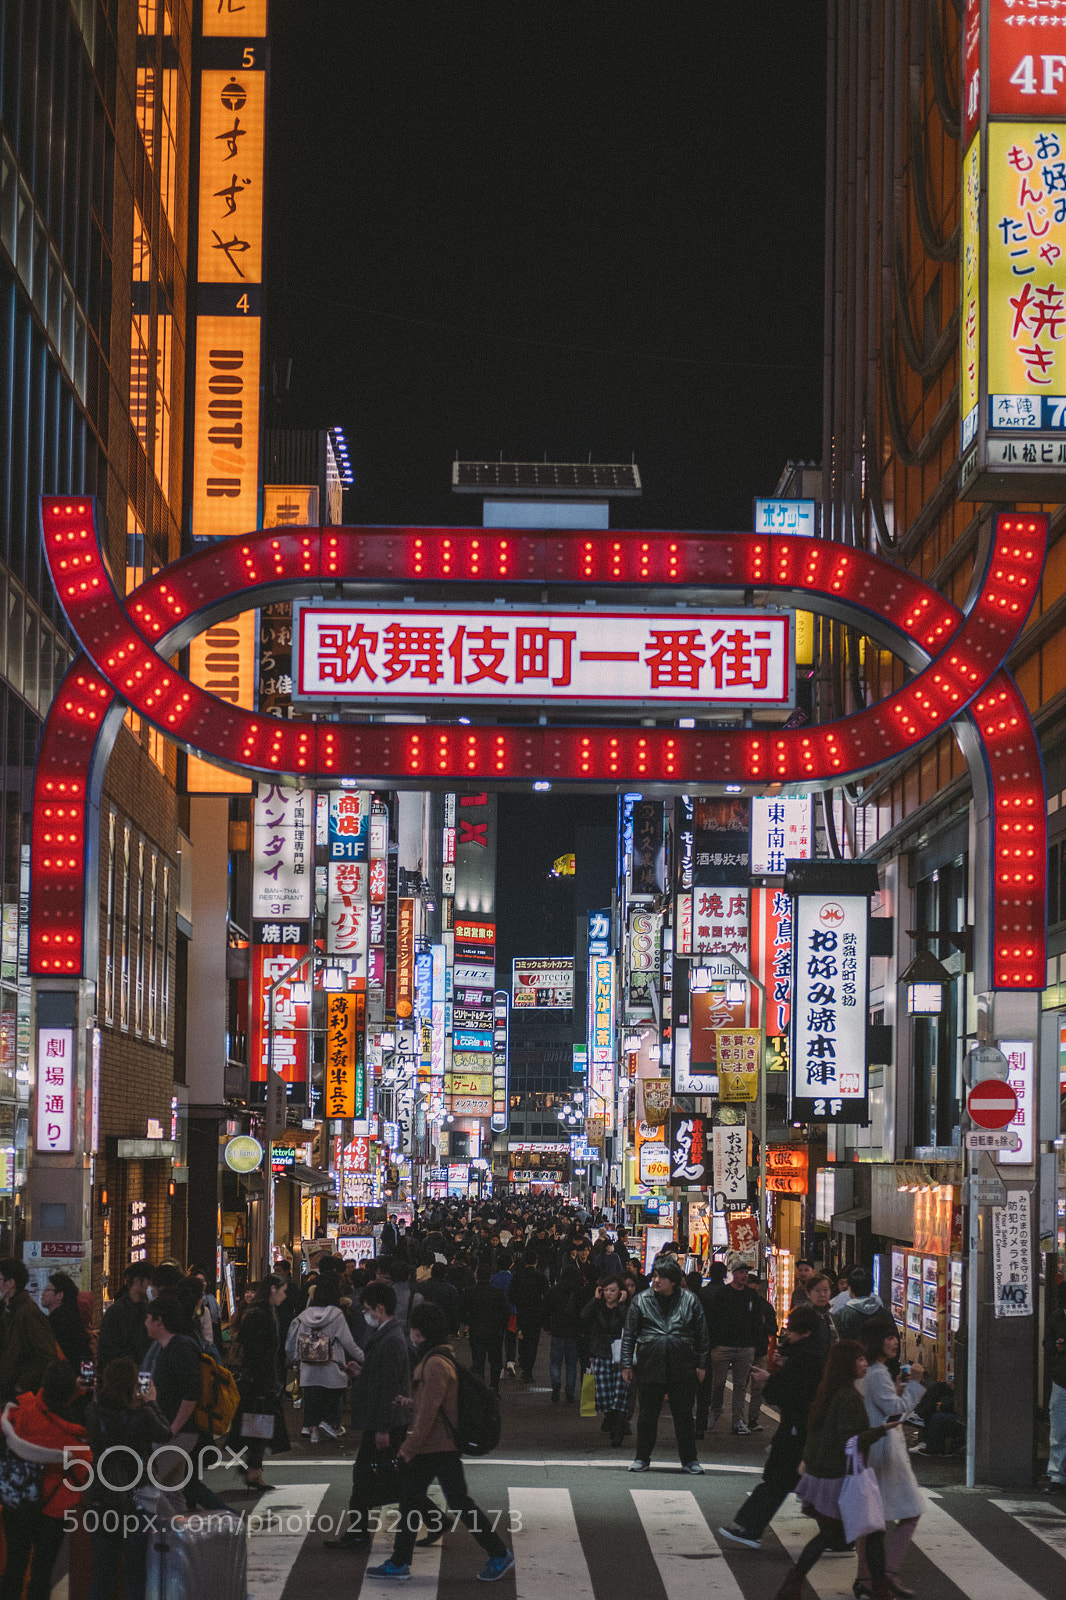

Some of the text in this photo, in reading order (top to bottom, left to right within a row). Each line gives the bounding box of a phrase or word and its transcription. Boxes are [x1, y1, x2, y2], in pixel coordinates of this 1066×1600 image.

[242, 48, 255, 68] 5
[1009, 55, 1066, 94] 4F
[236, 293, 250, 313] 4
[998, 414, 1036, 427] PART2
[317, 622, 773, 691] 歌舞伎町一番街
[767, 803, 785, 872] 東南荘
[332, 842, 365, 857] B1F
[270, 904, 292, 915] 3F
[262, 924, 300, 944] 焼肉
[807, 929, 838, 1086] お好み焼本陣
[721, 1036, 756, 1046] 悪質な
[721, 1049, 756, 1059] 客引き
[721, 1063, 756, 1072] に注意
[44, 1038, 66, 1141] 劇場通り
[813, 1099, 841, 1116] 2F
[970, 1136, 1015, 1147] 自転車を除く
[1008, 1201, 1019, 1283] 防犯カメラ作動
